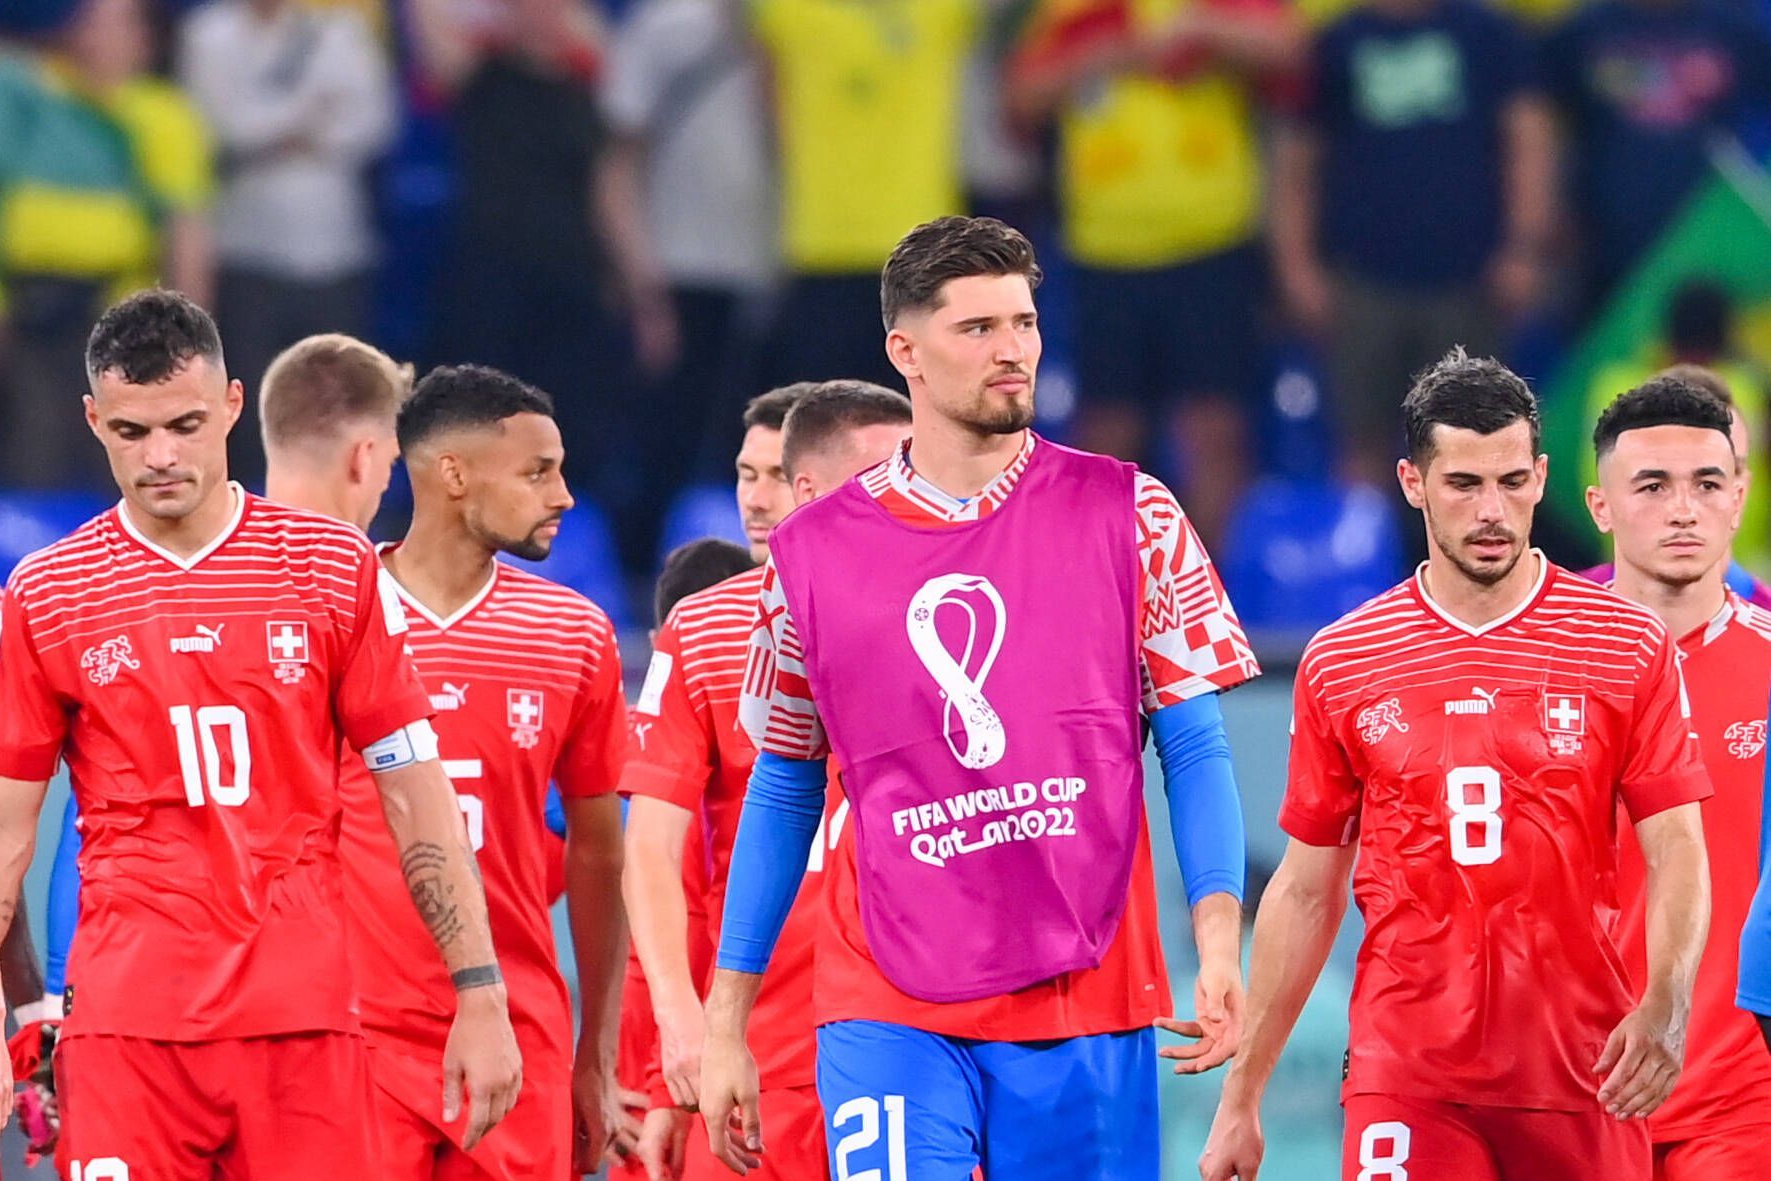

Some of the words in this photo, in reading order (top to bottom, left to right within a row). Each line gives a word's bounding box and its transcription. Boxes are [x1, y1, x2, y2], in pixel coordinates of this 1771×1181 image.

[169, 636, 214, 653] PUMA
[1444, 699, 1488, 716] PUMA
[169, 705, 250, 808] 10
[891, 801, 948, 836] FIFA
[945, 782, 1037, 821] WORLD
[1041, 777, 1087, 802] CUP
[1445, 765, 1502, 866] 8
